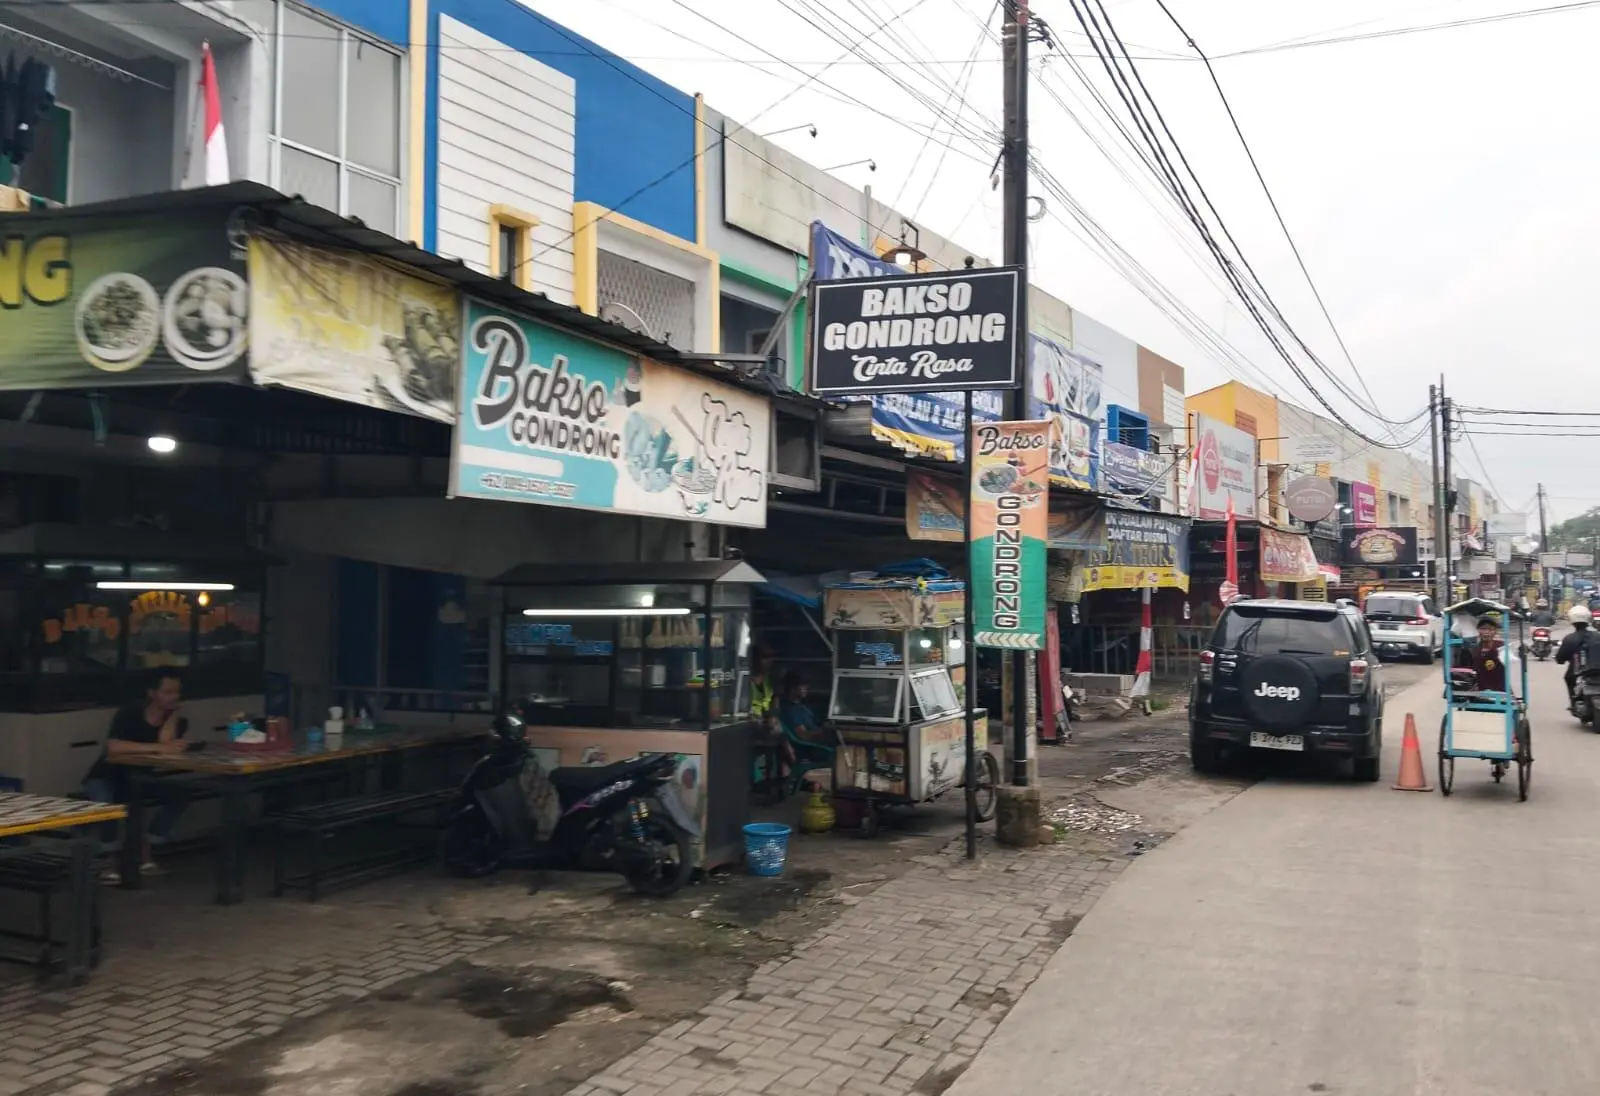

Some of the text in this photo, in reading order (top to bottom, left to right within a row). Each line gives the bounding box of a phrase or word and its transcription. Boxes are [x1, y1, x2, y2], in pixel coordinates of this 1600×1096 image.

[860, 281, 973, 318] BAKSO
[822, 311, 1007, 351] GONDRONG
[471, 315, 607, 430] Bakso
[851, 350, 974, 382] Cinta Rasa
[509, 410, 622, 461] GONDRONG
[976, 425, 1045, 456] Bakso
[992, 495, 1021, 630] GONDRONG
[1254, 682, 1300, 701] Jeep
